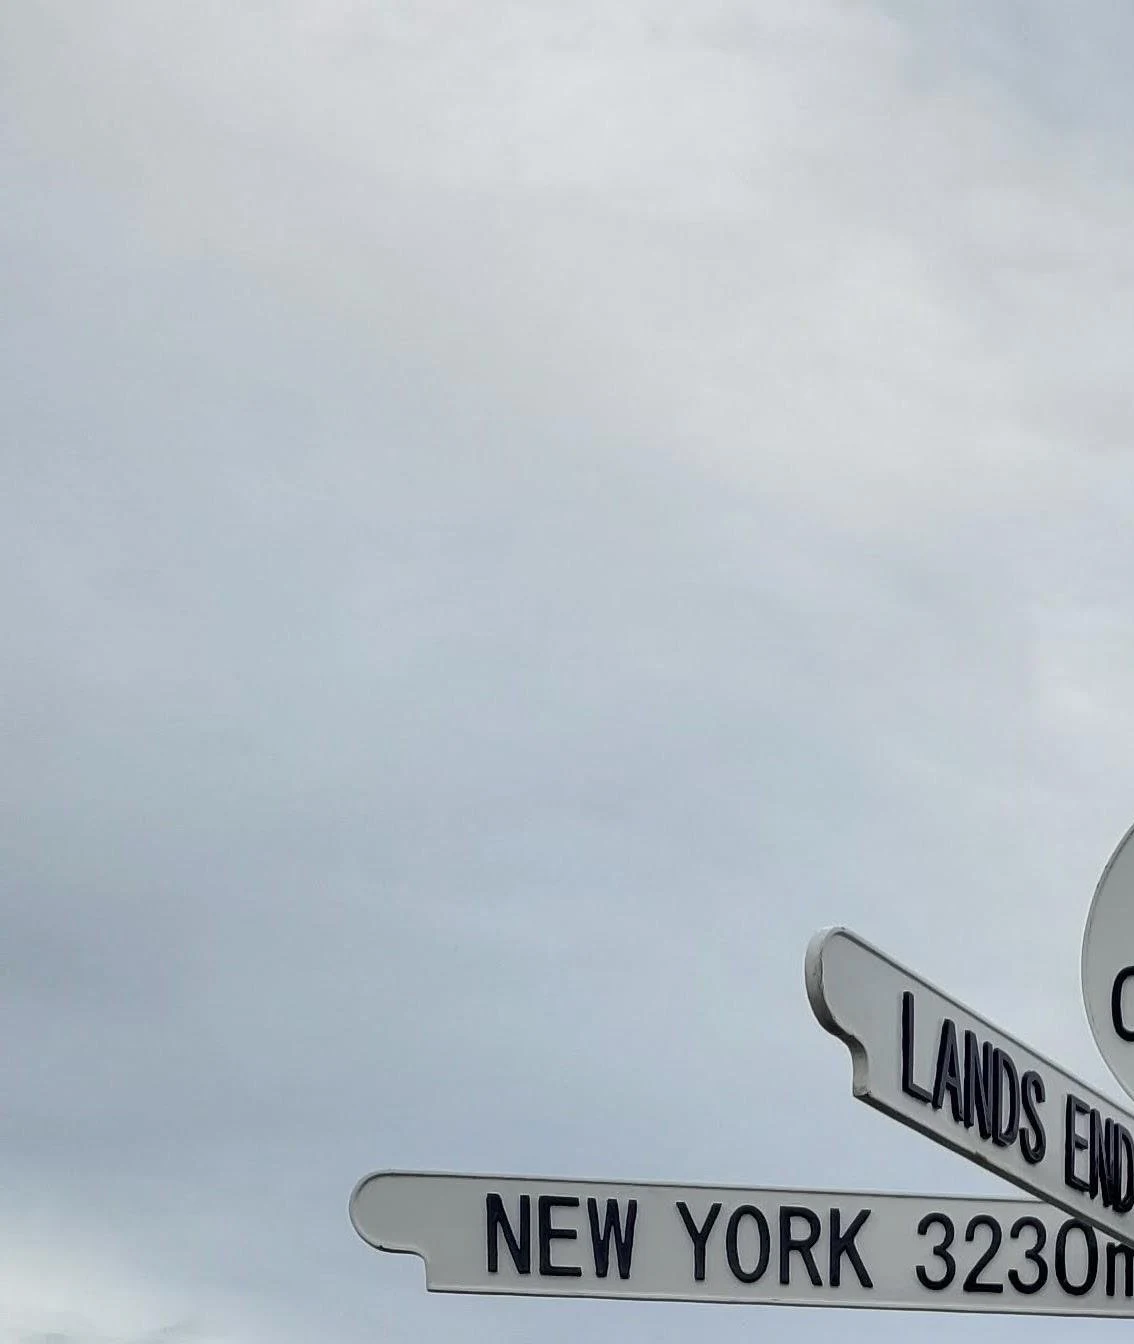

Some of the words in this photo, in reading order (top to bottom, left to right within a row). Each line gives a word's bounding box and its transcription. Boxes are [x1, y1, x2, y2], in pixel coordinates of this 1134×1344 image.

[901, 990, 1047, 1164] LANDS
[485, 1192, 638, 1280] NEW
[675, 1201, 874, 1289] YORK
